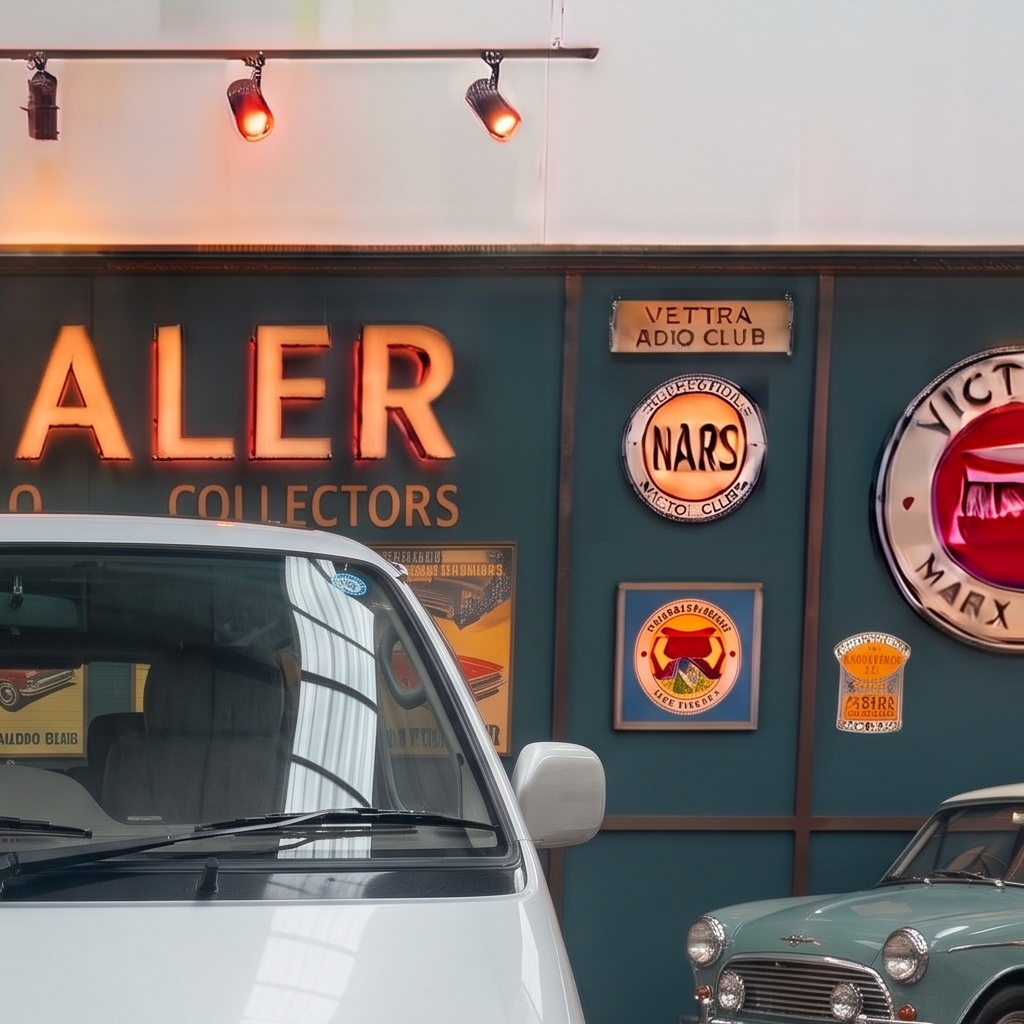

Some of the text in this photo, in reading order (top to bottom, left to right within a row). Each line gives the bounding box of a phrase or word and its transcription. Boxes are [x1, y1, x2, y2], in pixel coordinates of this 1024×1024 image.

[645, 306, 752, 325] VETTRA
[636, 328, 765, 348] ADIO CLUB
[652, 423, 739, 472] NARS
[167, 484, 459, 528] COLLECTORS
